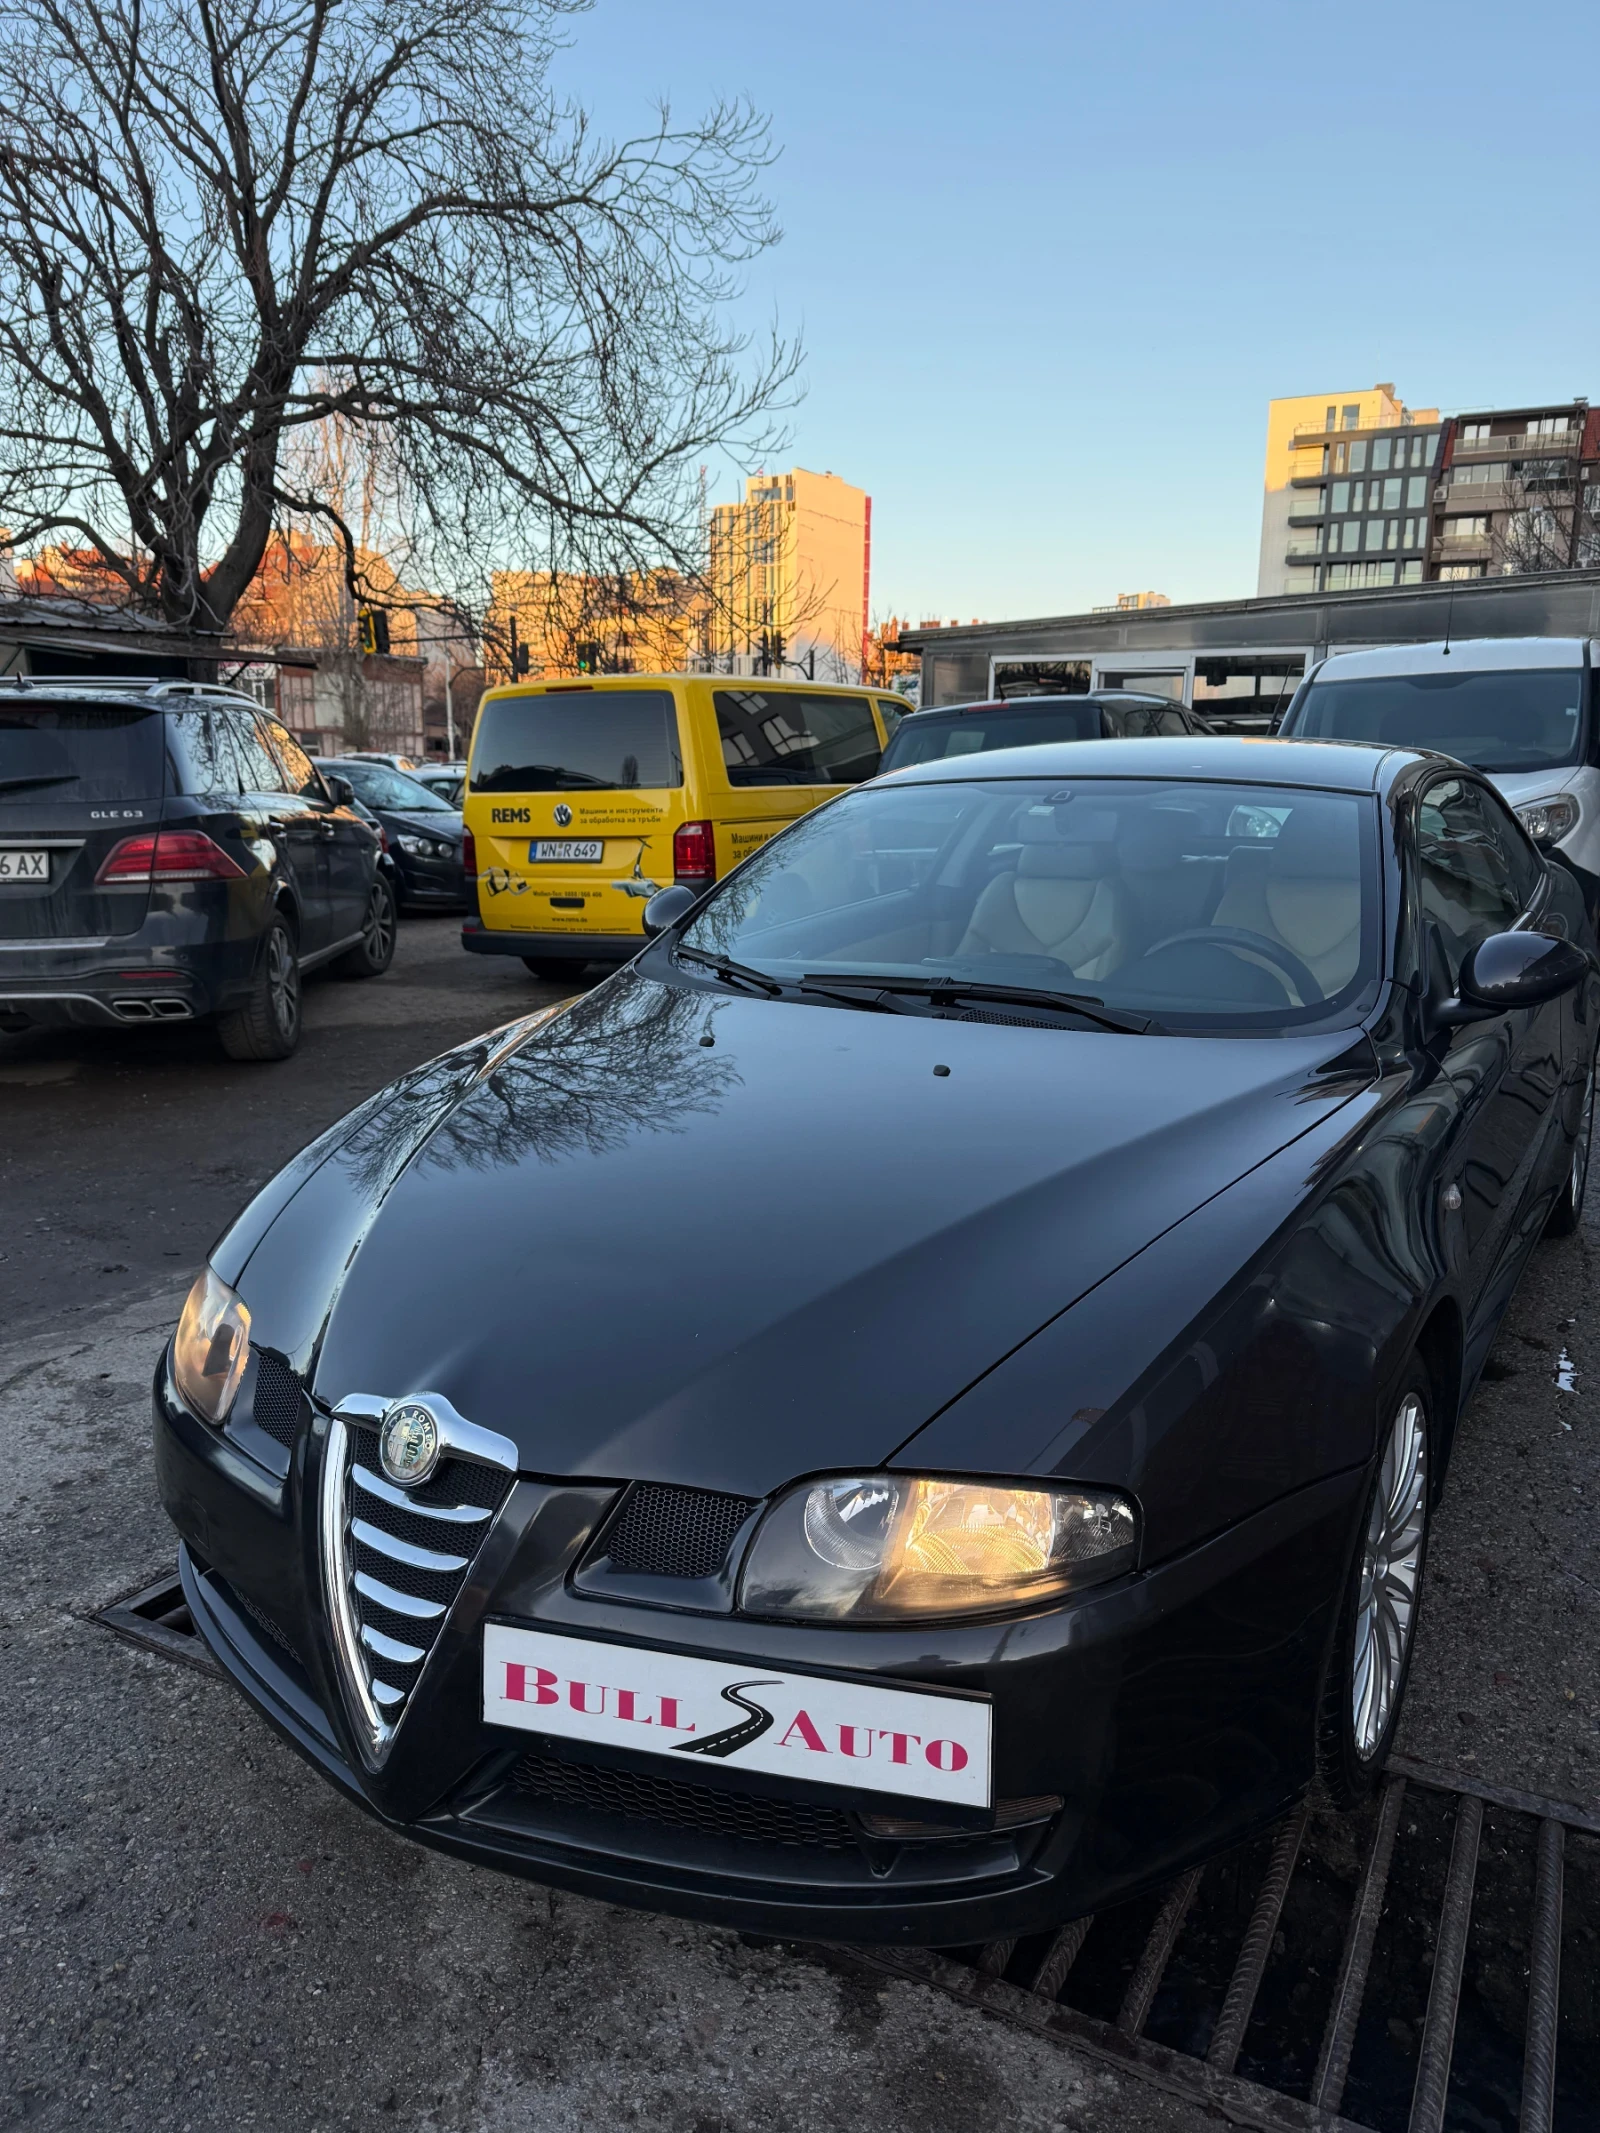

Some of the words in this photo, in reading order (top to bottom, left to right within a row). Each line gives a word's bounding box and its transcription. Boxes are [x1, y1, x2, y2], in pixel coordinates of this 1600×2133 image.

[90, 810, 119, 819] GLE
[123, 810, 144, 818] 63
[491, 807, 531, 823] REMS
[541, 843, 557, 857] WN
[574, 843, 598, 857] 649
[16, 855, 44, 875] AX
[412, 1409, 434, 1450] ROMEO
[498, 1660, 697, 1733] BULL
[773, 1709, 970, 1772] AUTO
